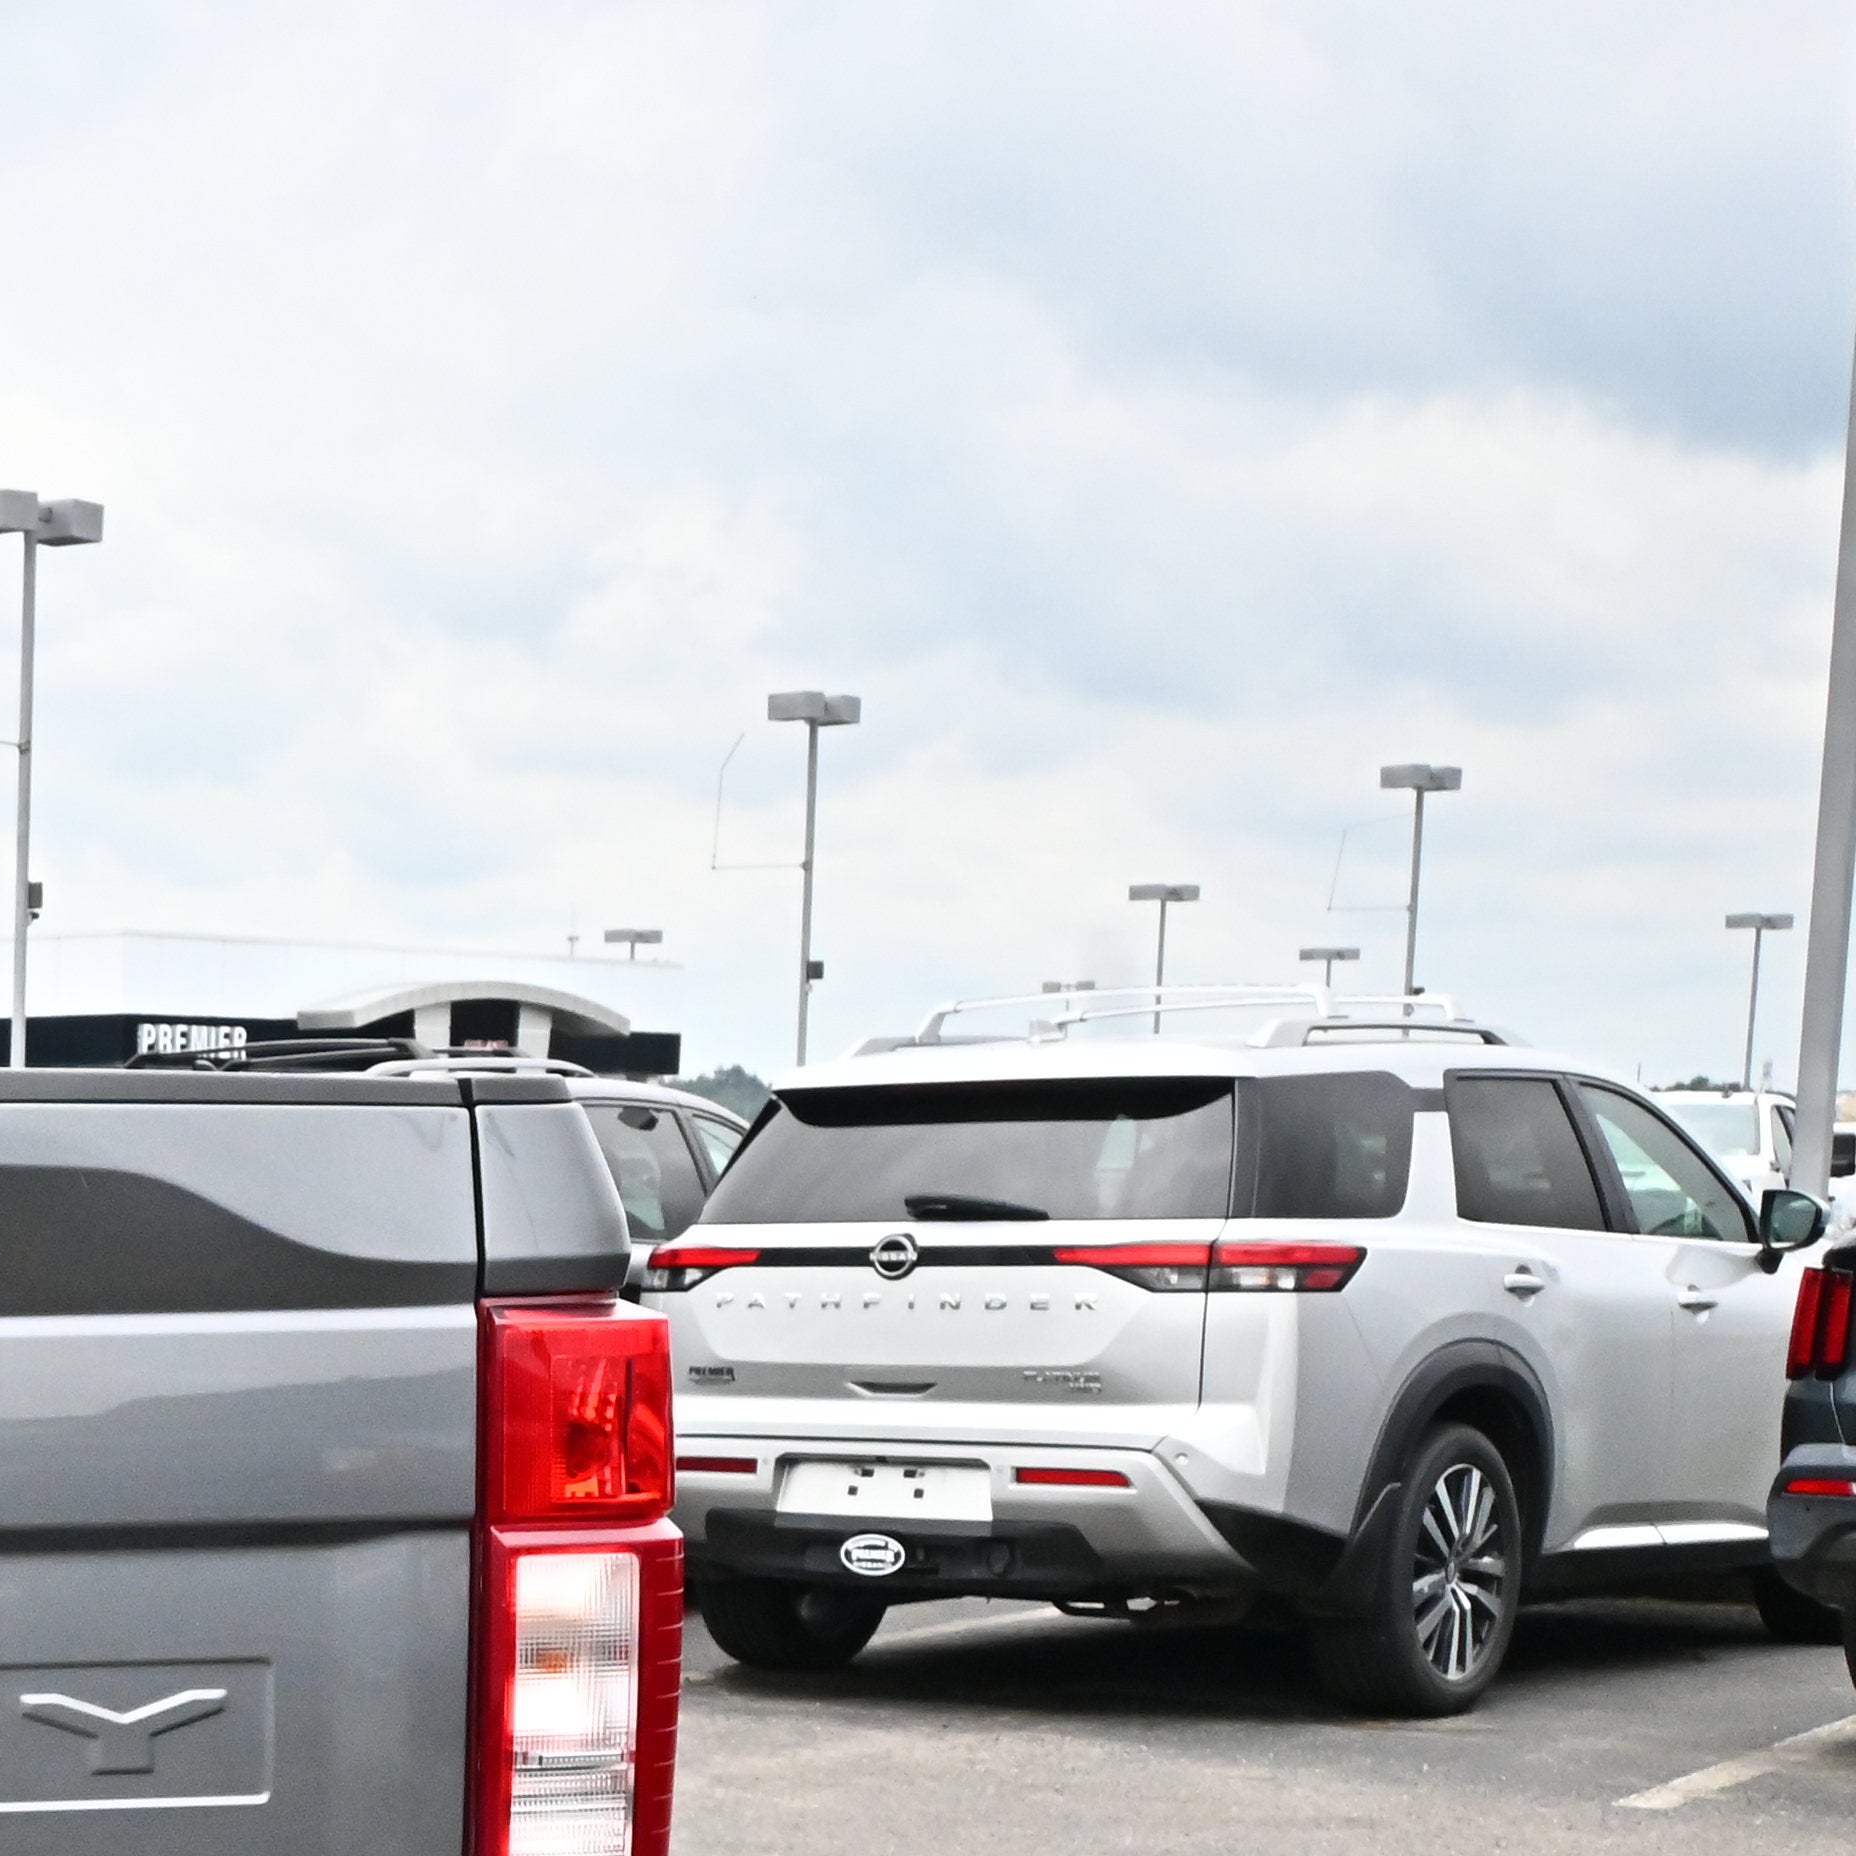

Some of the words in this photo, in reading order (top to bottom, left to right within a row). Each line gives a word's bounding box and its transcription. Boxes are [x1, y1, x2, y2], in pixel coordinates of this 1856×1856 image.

[138, 1023, 247, 1060] PREMIER
[869, 1251, 918, 1262] NISSAN
[715, 1291, 1099, 1311] PATHFINDER
